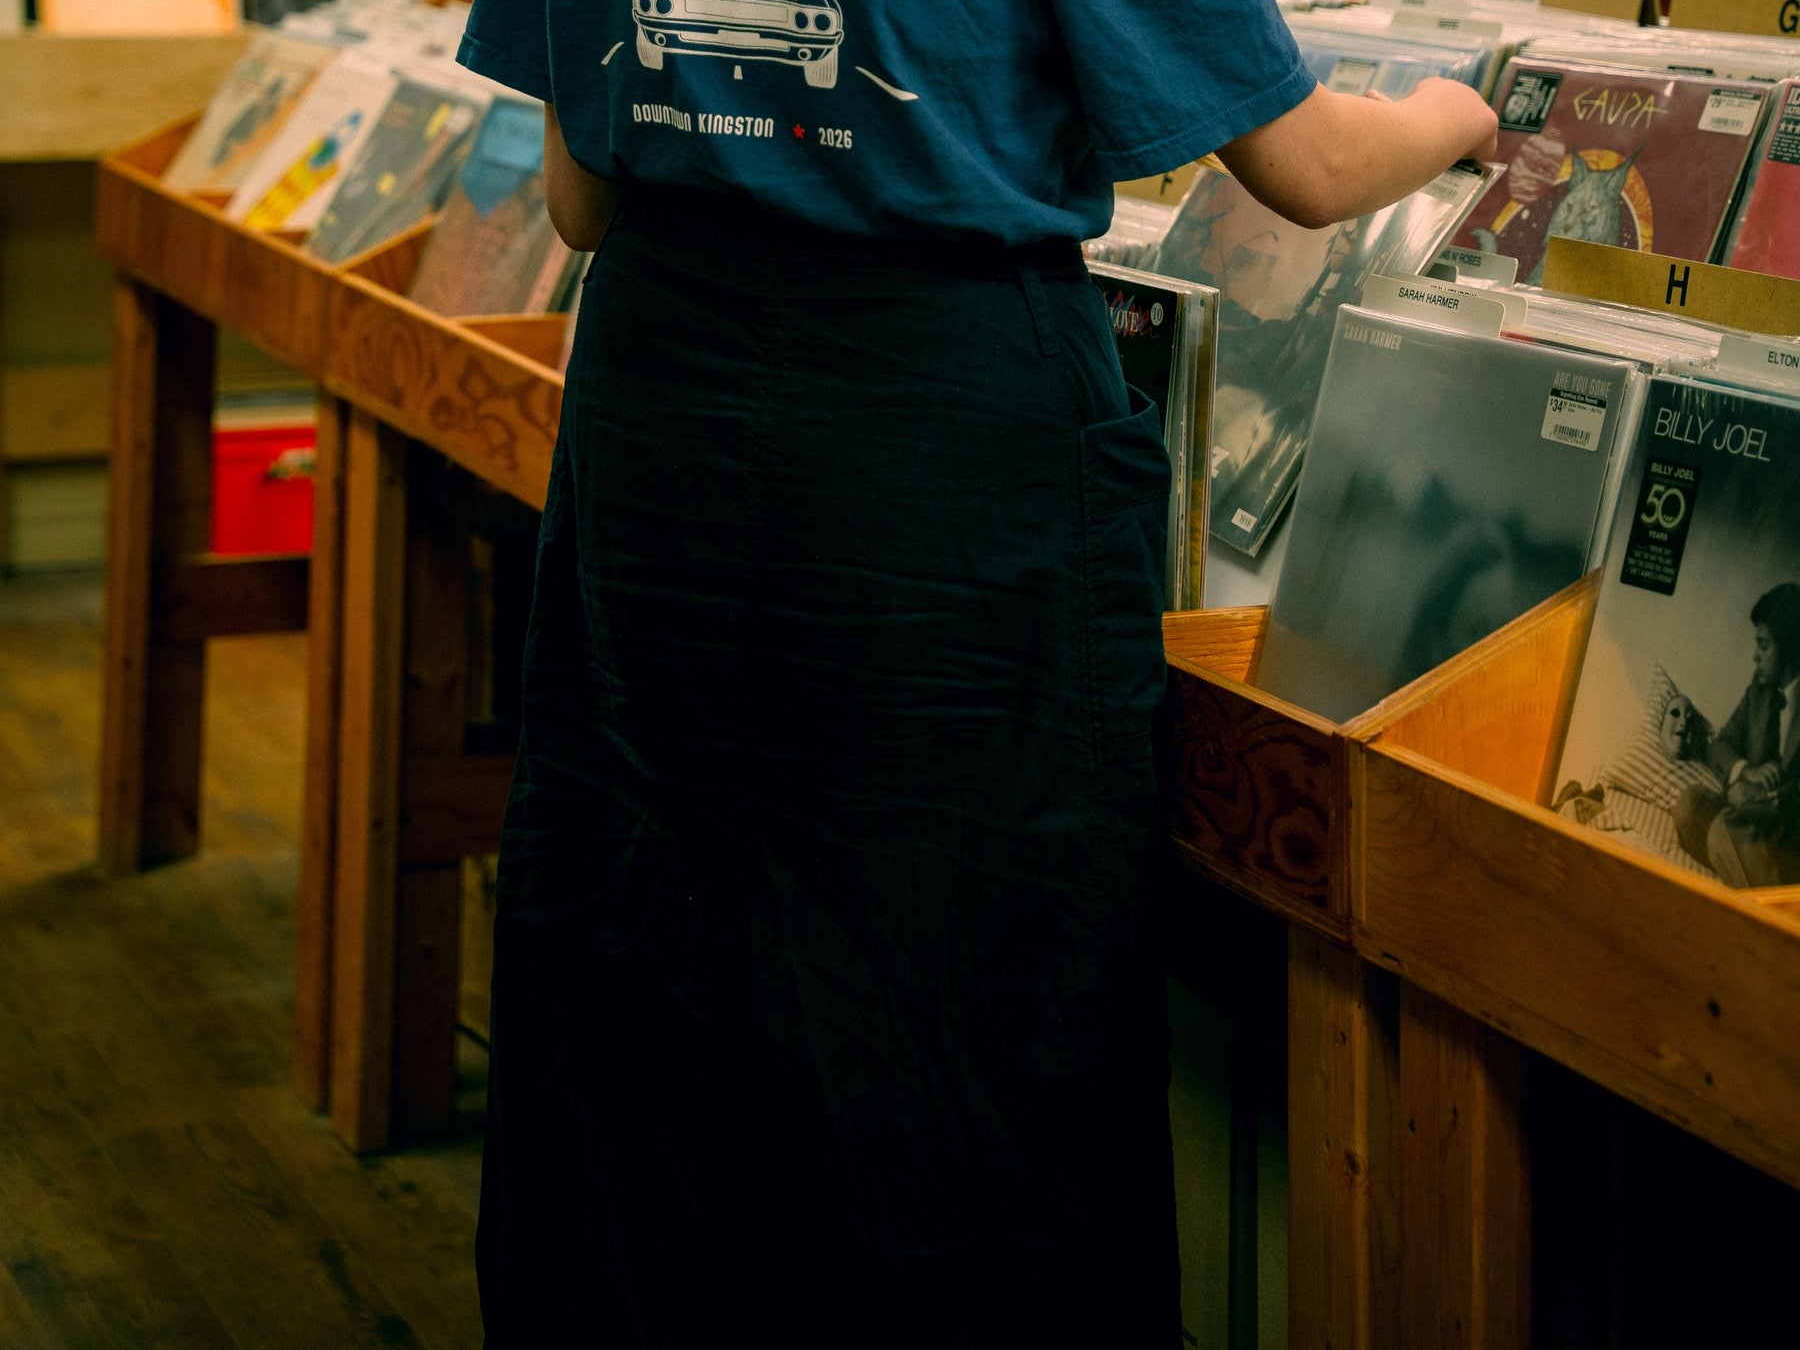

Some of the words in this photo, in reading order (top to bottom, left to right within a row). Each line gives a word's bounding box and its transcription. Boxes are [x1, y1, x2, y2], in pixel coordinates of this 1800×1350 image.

[633, 104, 691, 132] DOWNTOWN
[699, 113, 774, 138] KINGSTON
[818, 127, 852, 149] 2026
[1398, 287, 1426, 303] SARAH
[1426, 292, 1459, 310] HARMER
[1665, 264, 1690, 307] H
[1343, 324, 1368, 342] SARAH
[1368, 329, 1402, 350] HARMER
[1768, 351, 1800, 368] ELTON
[1553, 371, 1570, 389] ARE
[1571, 374, 1588, 393] YOU
[1589, 378, 1611, 398] GONE
[1654, 407, 1713, 445] BILLY
[1713, 419, 1770, 462] JOEL
[1650, 462, 1674, 477] BILLY
[1674, 467, 1695, 481] JOEL
[1641, 483, 1686, 529] 50
[1649, 530, 1668, 541] YEARS
